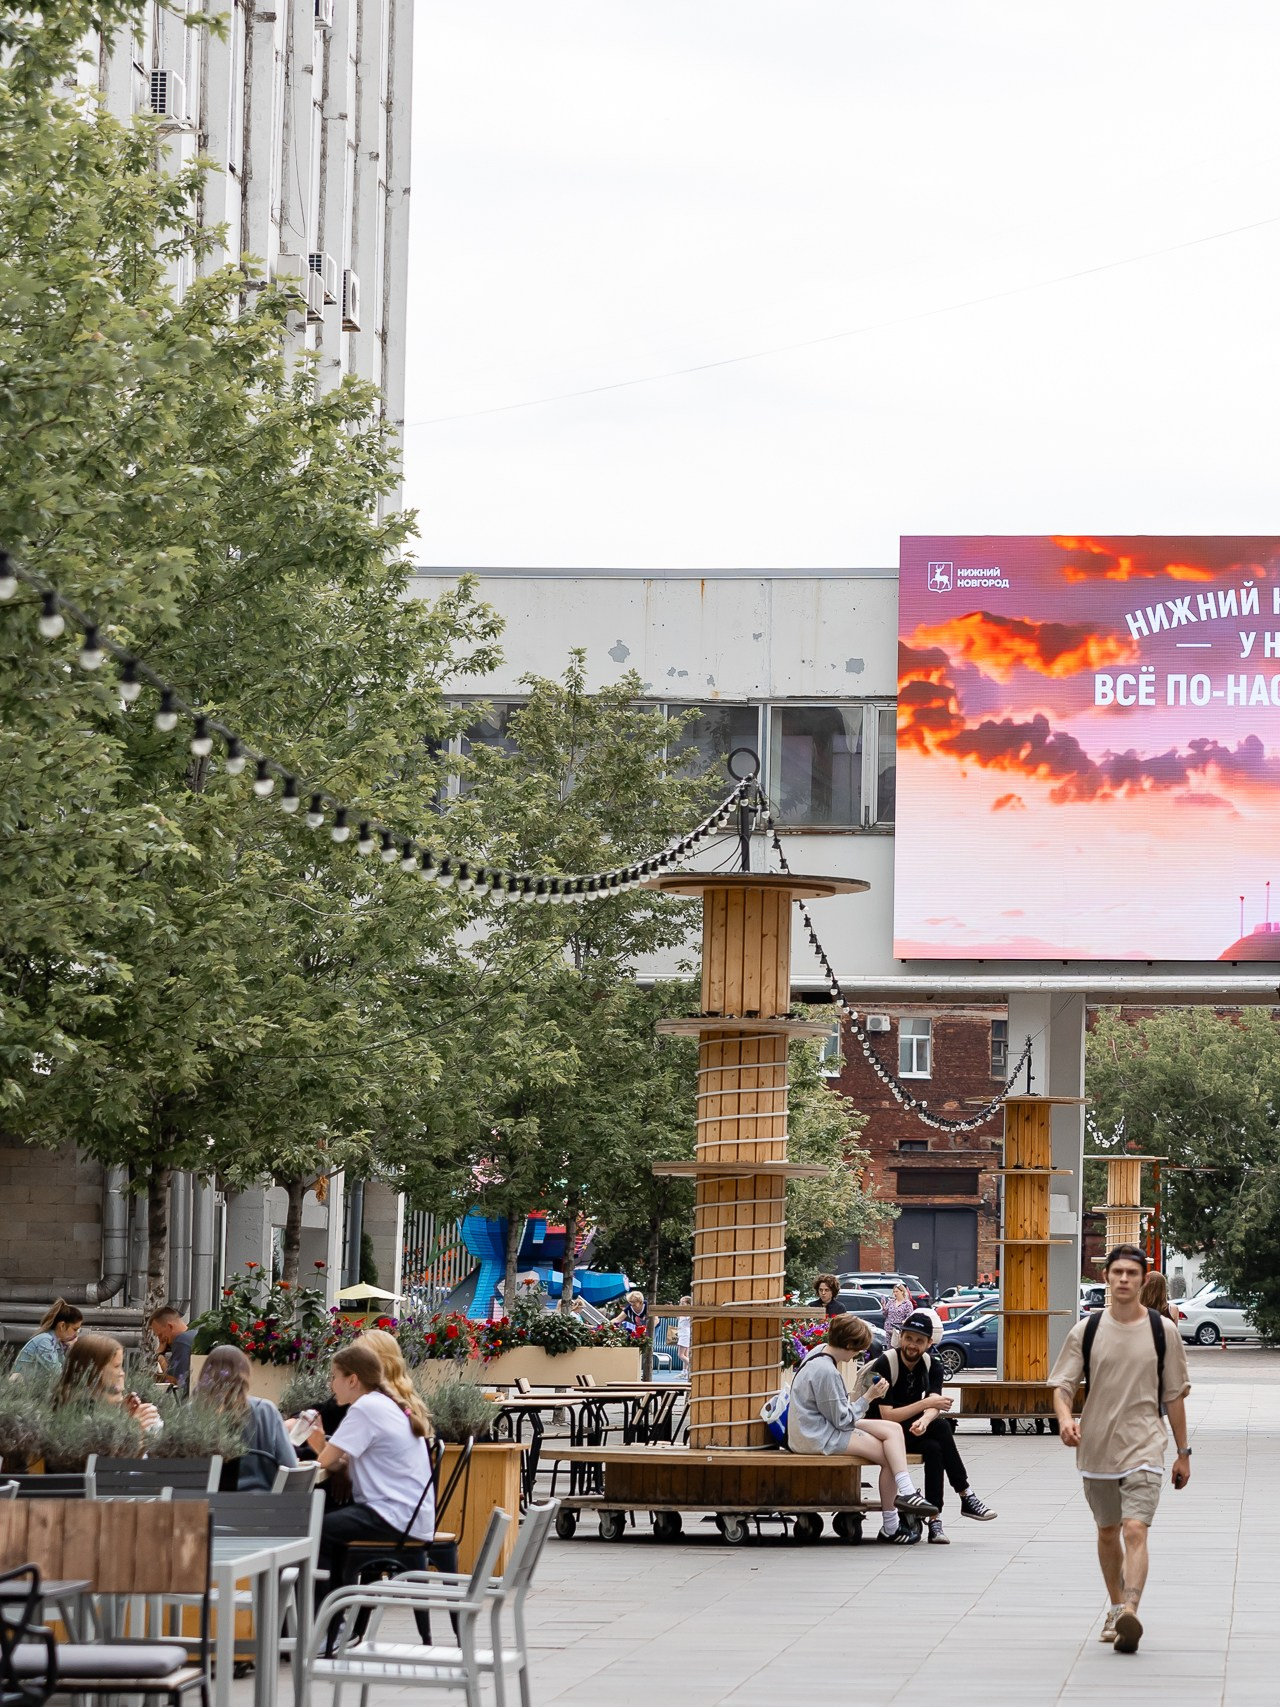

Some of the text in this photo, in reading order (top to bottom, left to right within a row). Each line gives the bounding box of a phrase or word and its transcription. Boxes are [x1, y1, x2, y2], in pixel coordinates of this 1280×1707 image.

[957, 567, 1001, 577] НИЖНИЙ
[957, 579, 1010, 588] НОВГОРОД
[1124, 580, 1260, 640] НИЖНИЙ
[1238, 631, 1257, 659] У
[1094, 665, 1156, 706] ВСЁ
